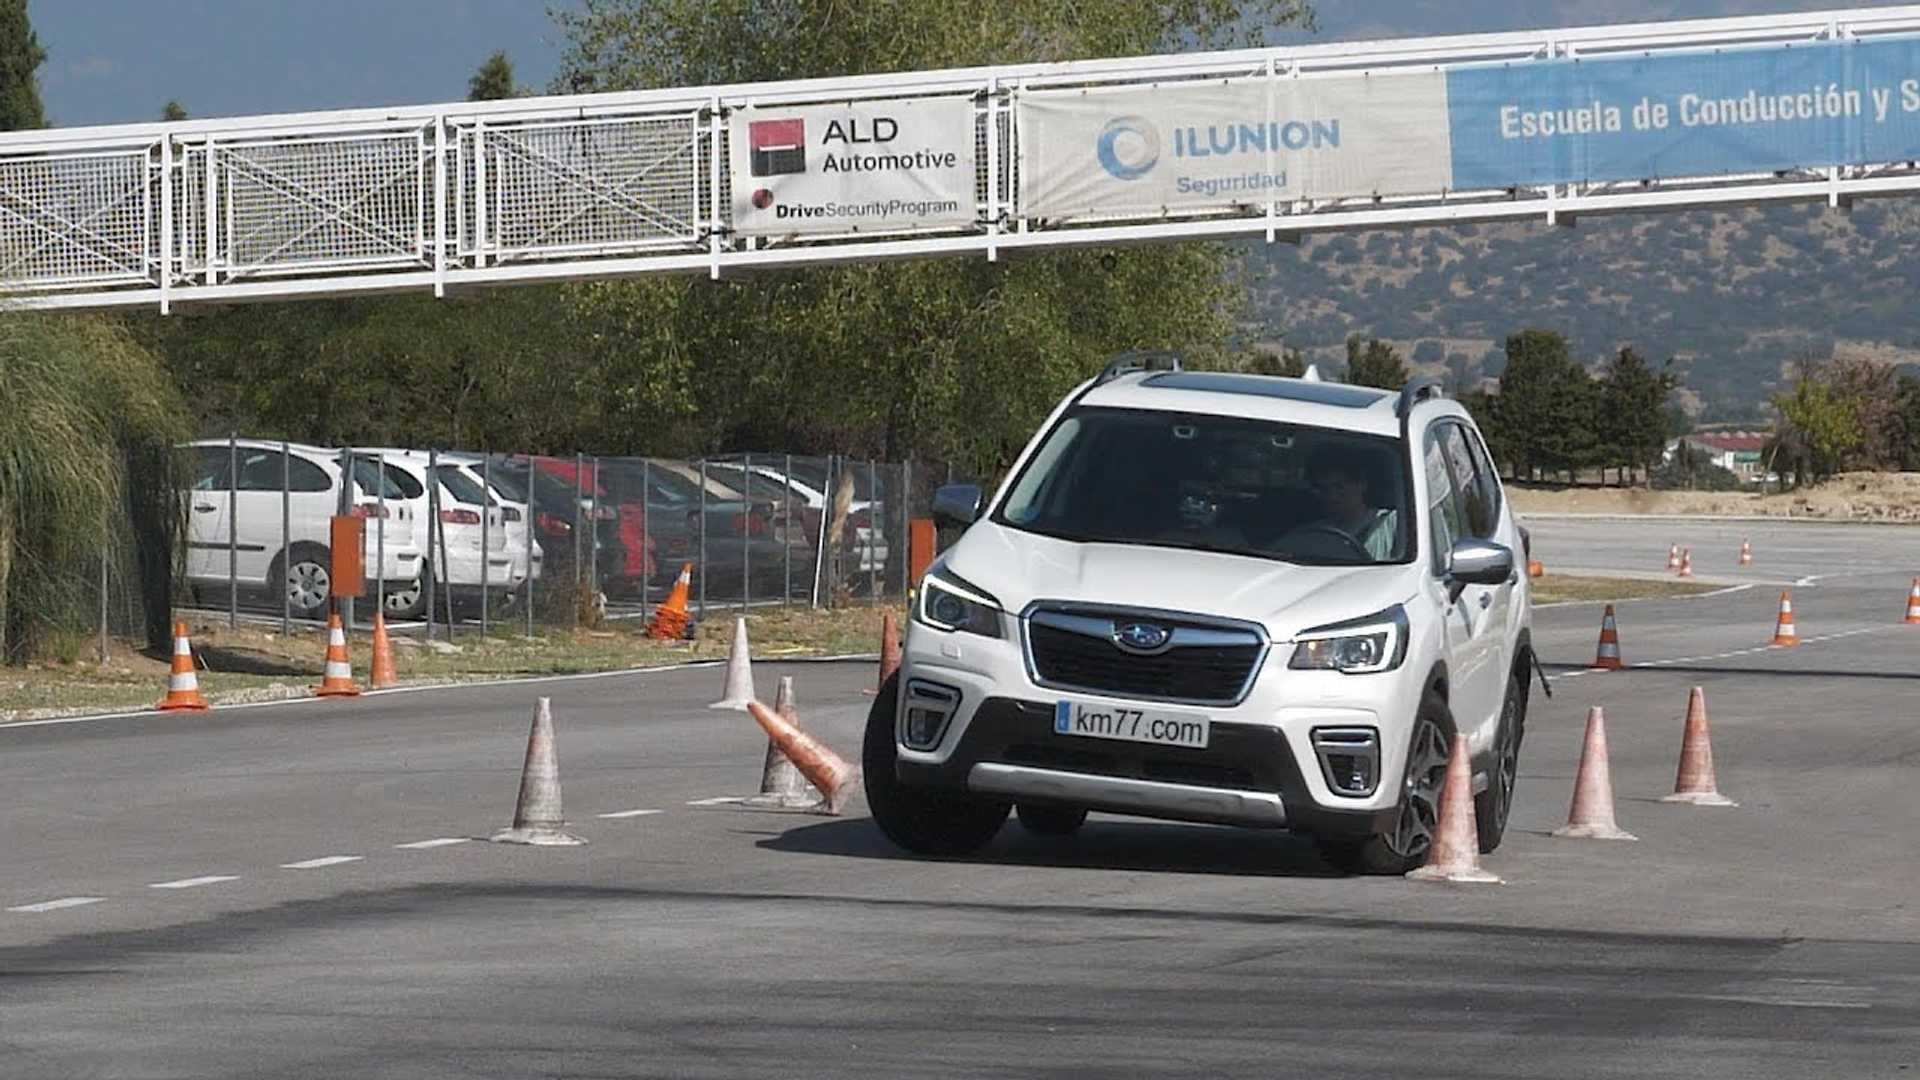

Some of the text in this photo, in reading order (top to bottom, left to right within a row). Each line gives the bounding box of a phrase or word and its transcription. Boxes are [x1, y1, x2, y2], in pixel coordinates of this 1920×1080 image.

[1501, 102, 1622, 139] Escuela
[1632, 97, 1669, 130] de
[1679, 83, 1861, 127] Conducción
[1872, 86, 1890, 122] y
[822, 117, 899, 146] ALD
[1174, 118, 1341, 158] ILUNION
[822, 148, 957, 173] Automotive
[1176, 170, 1287, 196] Seguridad
[1076, 705, 1203, 743] km77.com
